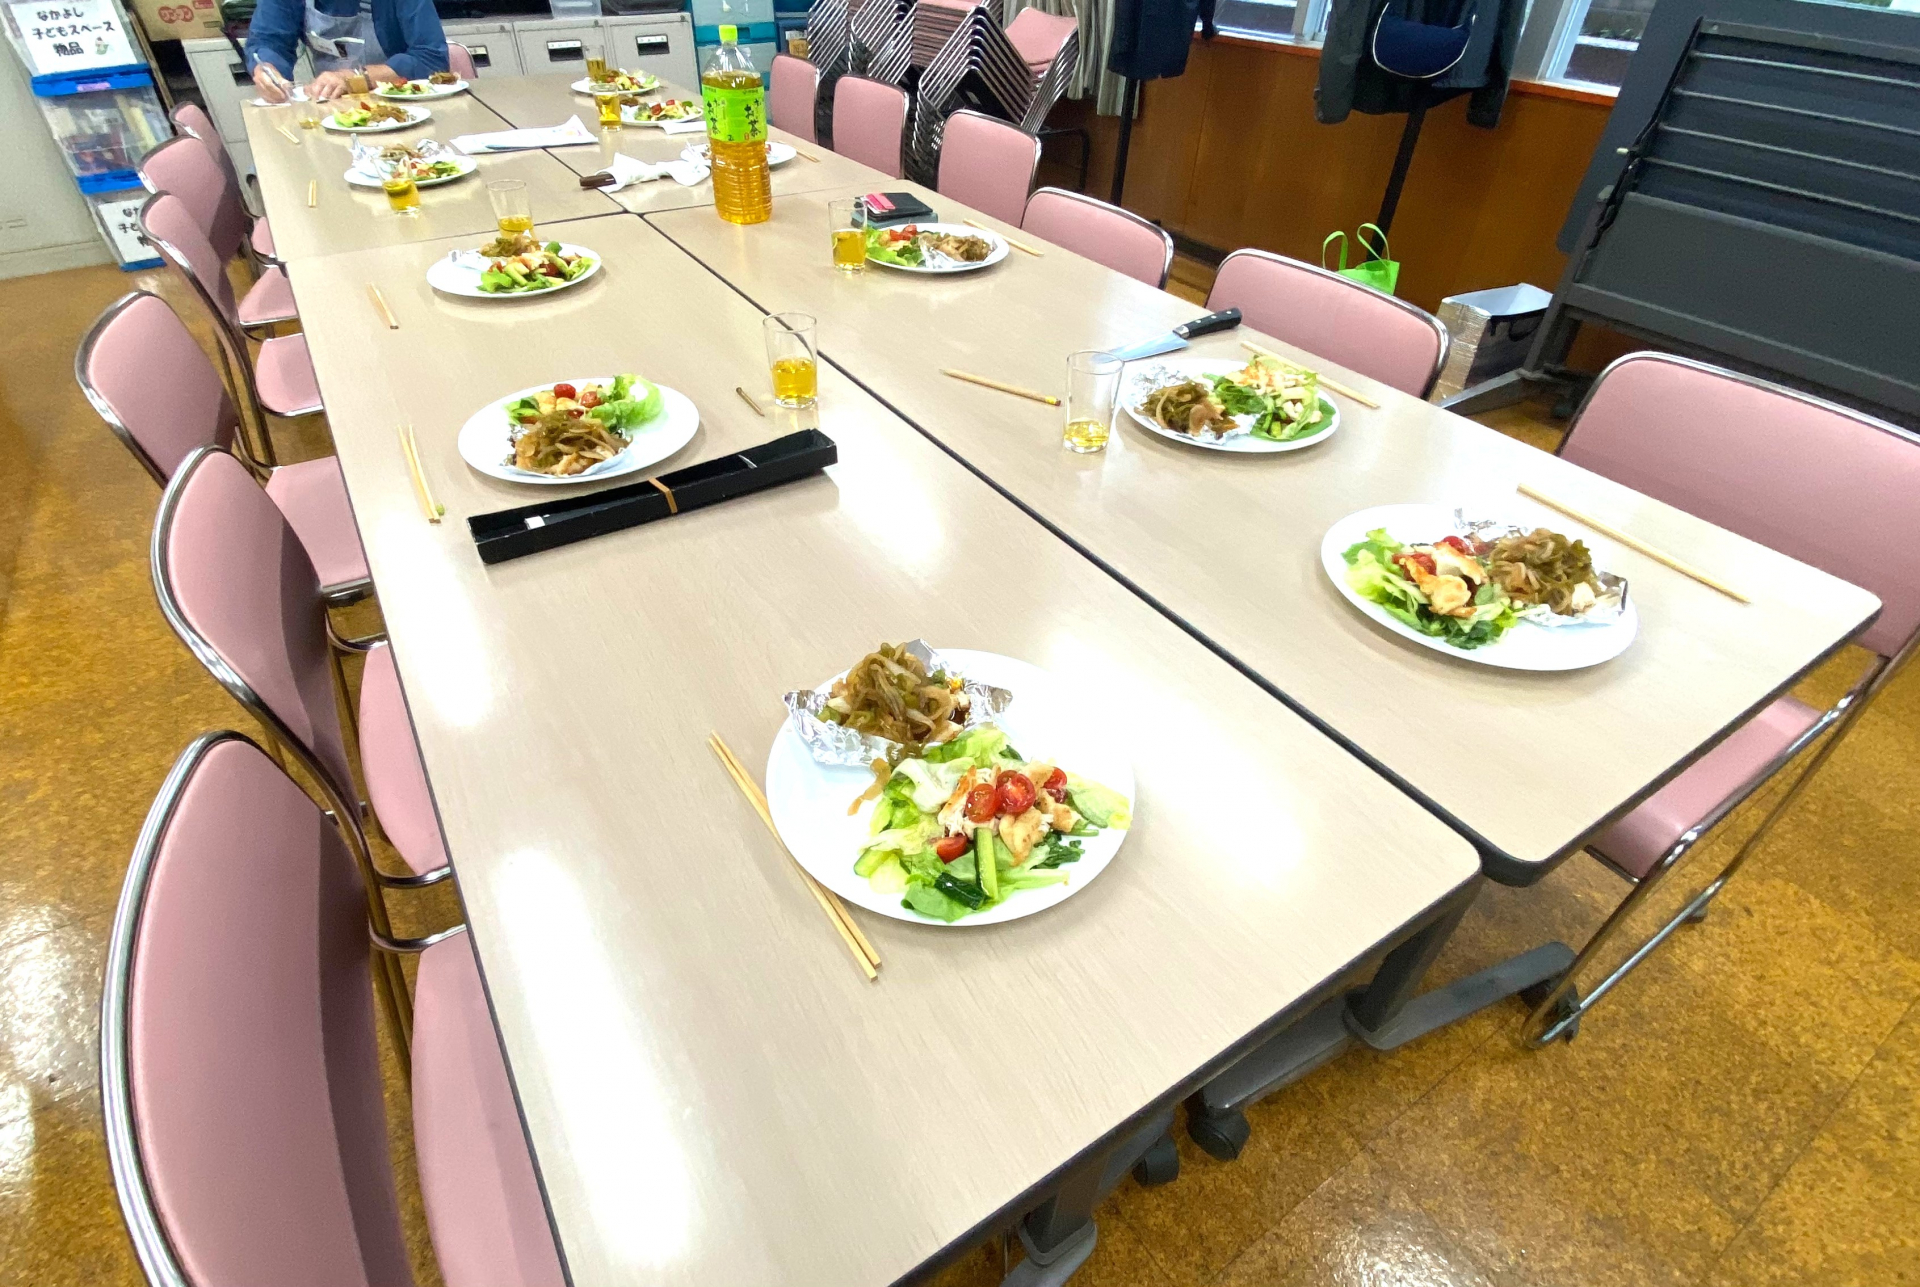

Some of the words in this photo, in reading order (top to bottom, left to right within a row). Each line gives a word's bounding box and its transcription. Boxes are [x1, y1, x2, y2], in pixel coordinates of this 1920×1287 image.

[36, 7, 84, 21] なかよし
[32, 20, 115, 40] 子どもスペース
[52, 41, 84, 57] 物品
[744, 103, 762, 138] お茶
